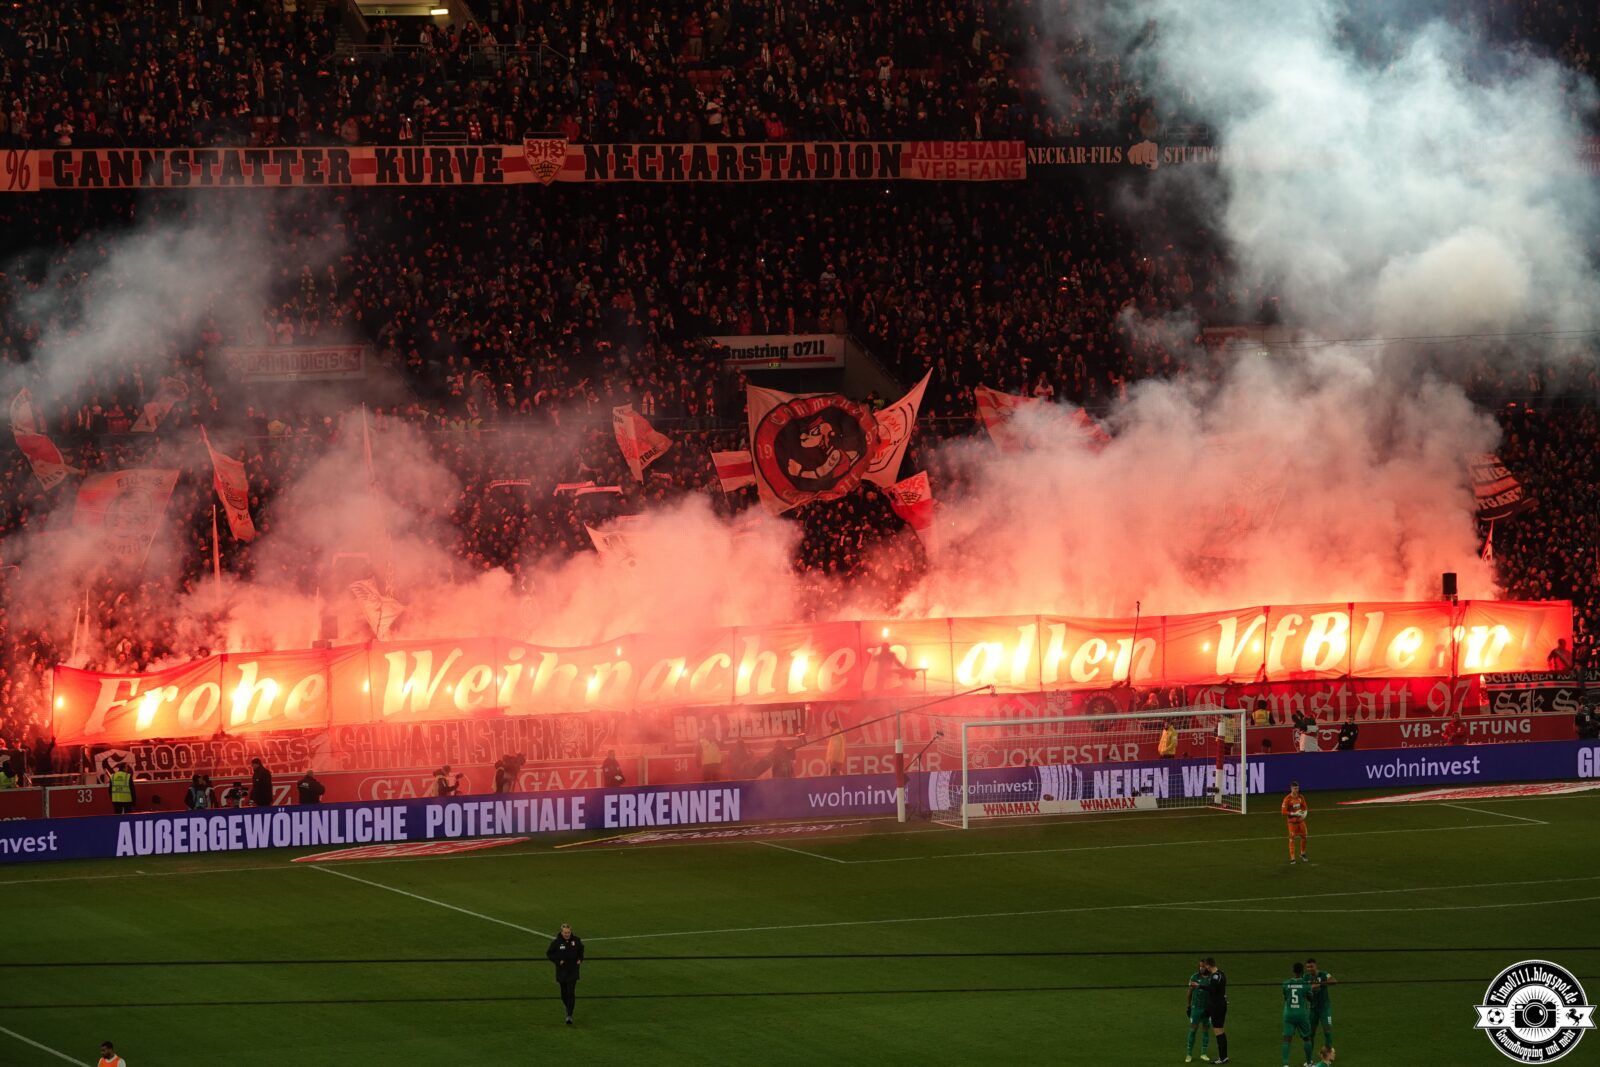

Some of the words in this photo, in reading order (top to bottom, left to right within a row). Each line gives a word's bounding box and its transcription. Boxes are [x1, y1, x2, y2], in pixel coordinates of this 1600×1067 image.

[914, 140, 1025, 160] ALBSTADT
[1027, 146, 1122, 165] NECKAR-FILS
[52, 148, 352, 187] CANNSTATTER
[374, 146, 504, 184] KURVE
[583, 144, 899, 180] NECKARSTADION
[916, 160, 1023, 180] VFB-FANS
[793, 340, 825, 356] 0711
[85, 661, 325, 734] Frohe
[957, 622, 1157, 686] allen
[131, 736, 311, 772] HOOLIGANS
[674, 758, 688, 772] 34
[1366, 755, 1480, 780] wohninvest
[77, 789, 93, 803] 33
[1080, 797, 1138, 811] WINAMAX
[426, 796, 586, 838] POTENTIALE
[603, 788, 741, 829] ERKENNEN
[983, 802, 1041, 817] WINAMAX
[1291, 988, 1300, 1004] 5
